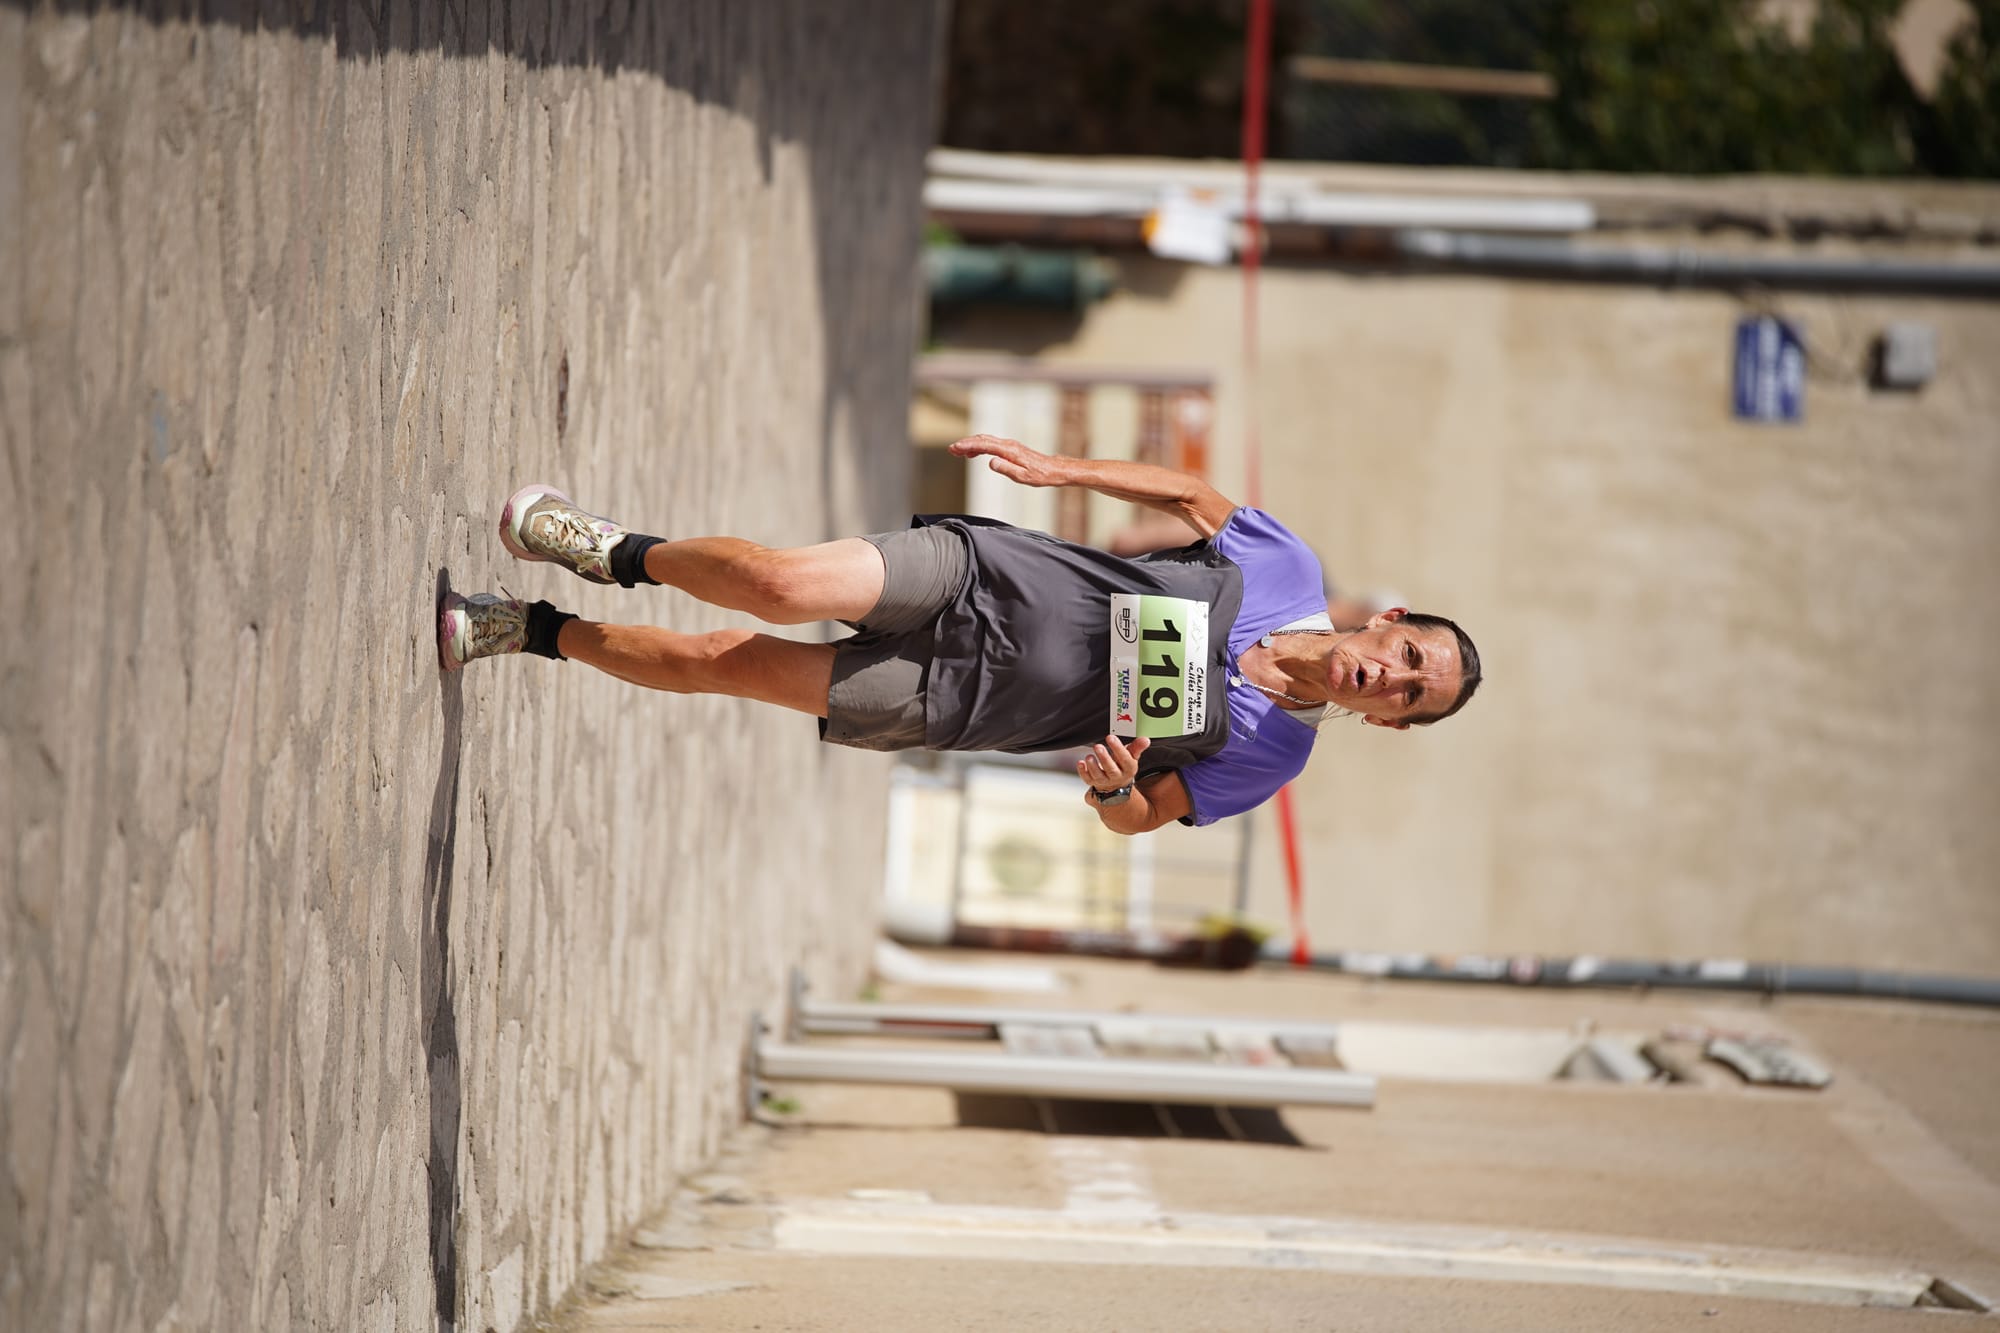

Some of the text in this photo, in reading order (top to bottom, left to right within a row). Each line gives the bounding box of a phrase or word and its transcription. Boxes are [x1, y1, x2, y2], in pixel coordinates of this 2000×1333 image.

[1122, 608, 1130, 638] BFP
[1140, 619, 1181, 719] 119
[1194, 667, 1204, 709] Challenge
